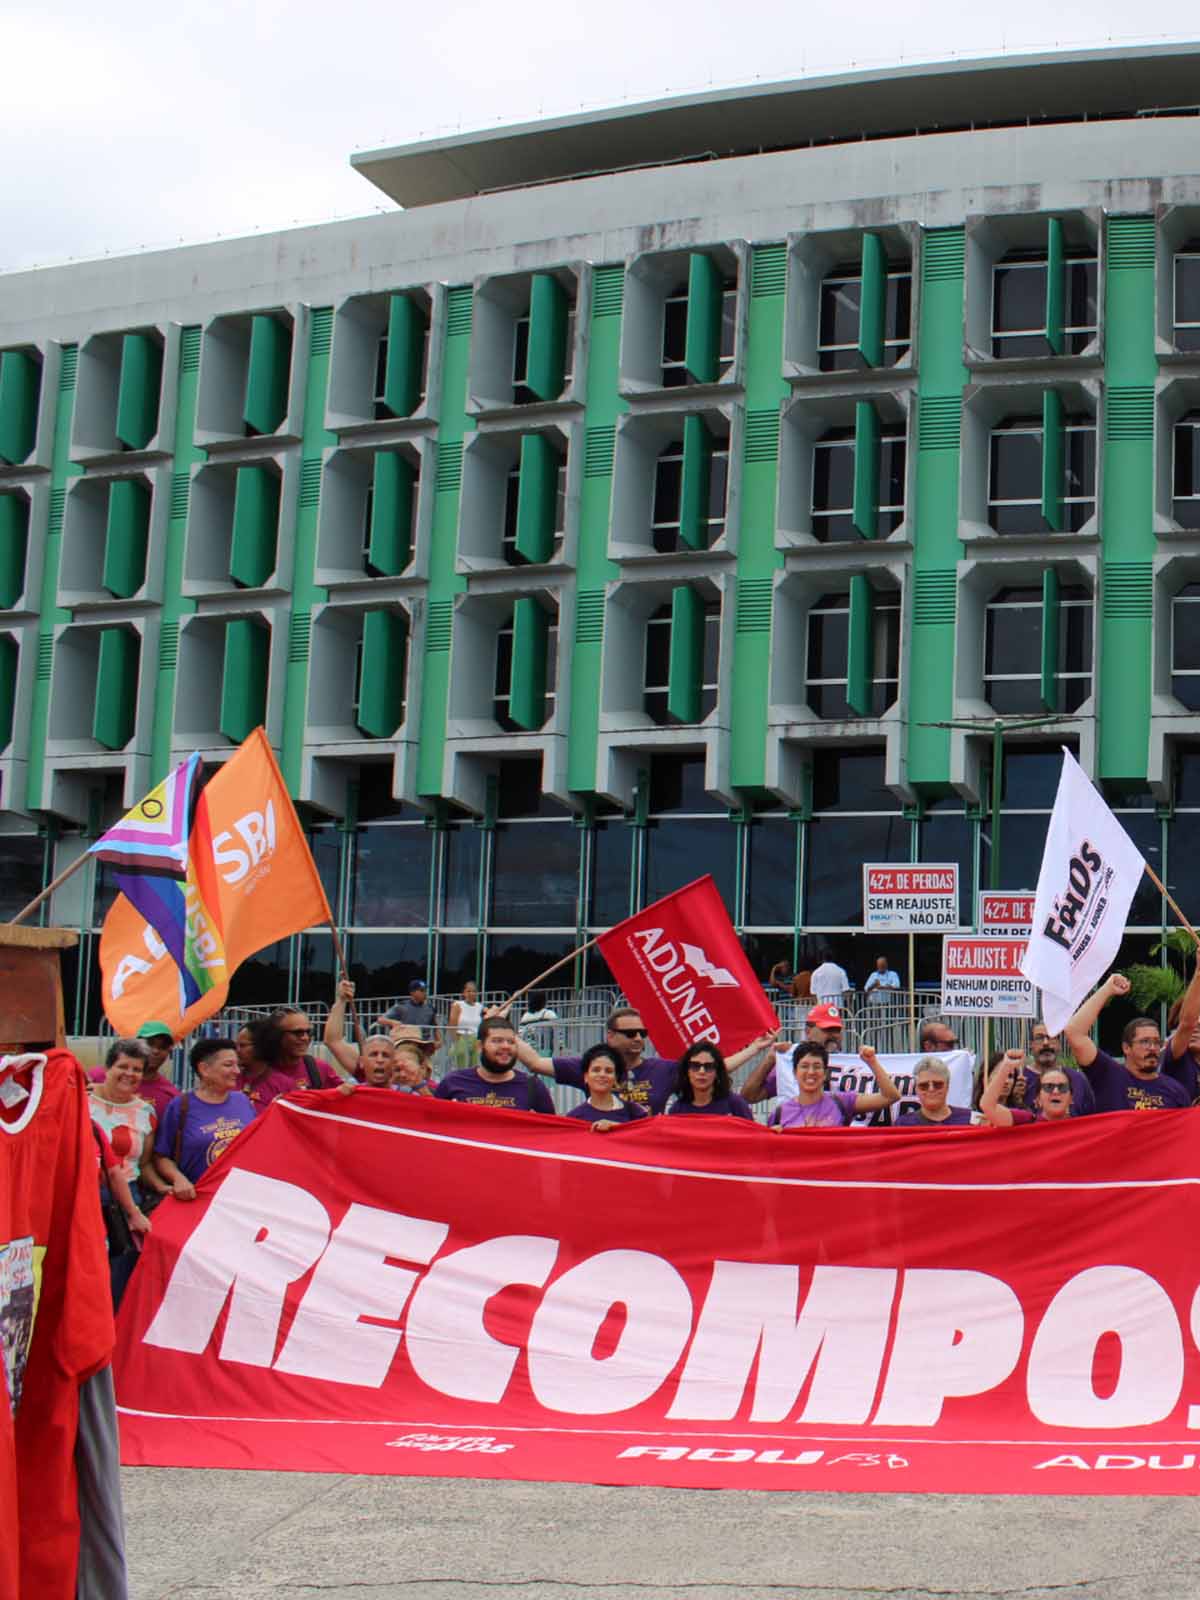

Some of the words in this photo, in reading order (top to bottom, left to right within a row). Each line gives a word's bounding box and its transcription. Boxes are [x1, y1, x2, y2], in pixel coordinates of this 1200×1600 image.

[870, 873, 893, 889] 42%
[897, 873, 908, 889] DE
[912, 873, 953, 890] PERDAS
[868, 898, 893, 911] SEM
[896, 897, 955, 911] REAJUSTE,
[984, 902, 1009, 919] 42%
[1013, 902, 1025, 920] DE
[909, 911, 934, 925] NÃO
[949, 946, 1008, 970] REAJUSTE
[945, 979, 988, 992] NENHUM
[990, 980, 1032, 993] DIREITO
[945, 995, 953, 1008] A
[954, 995, 994, 1009] MENOS!
